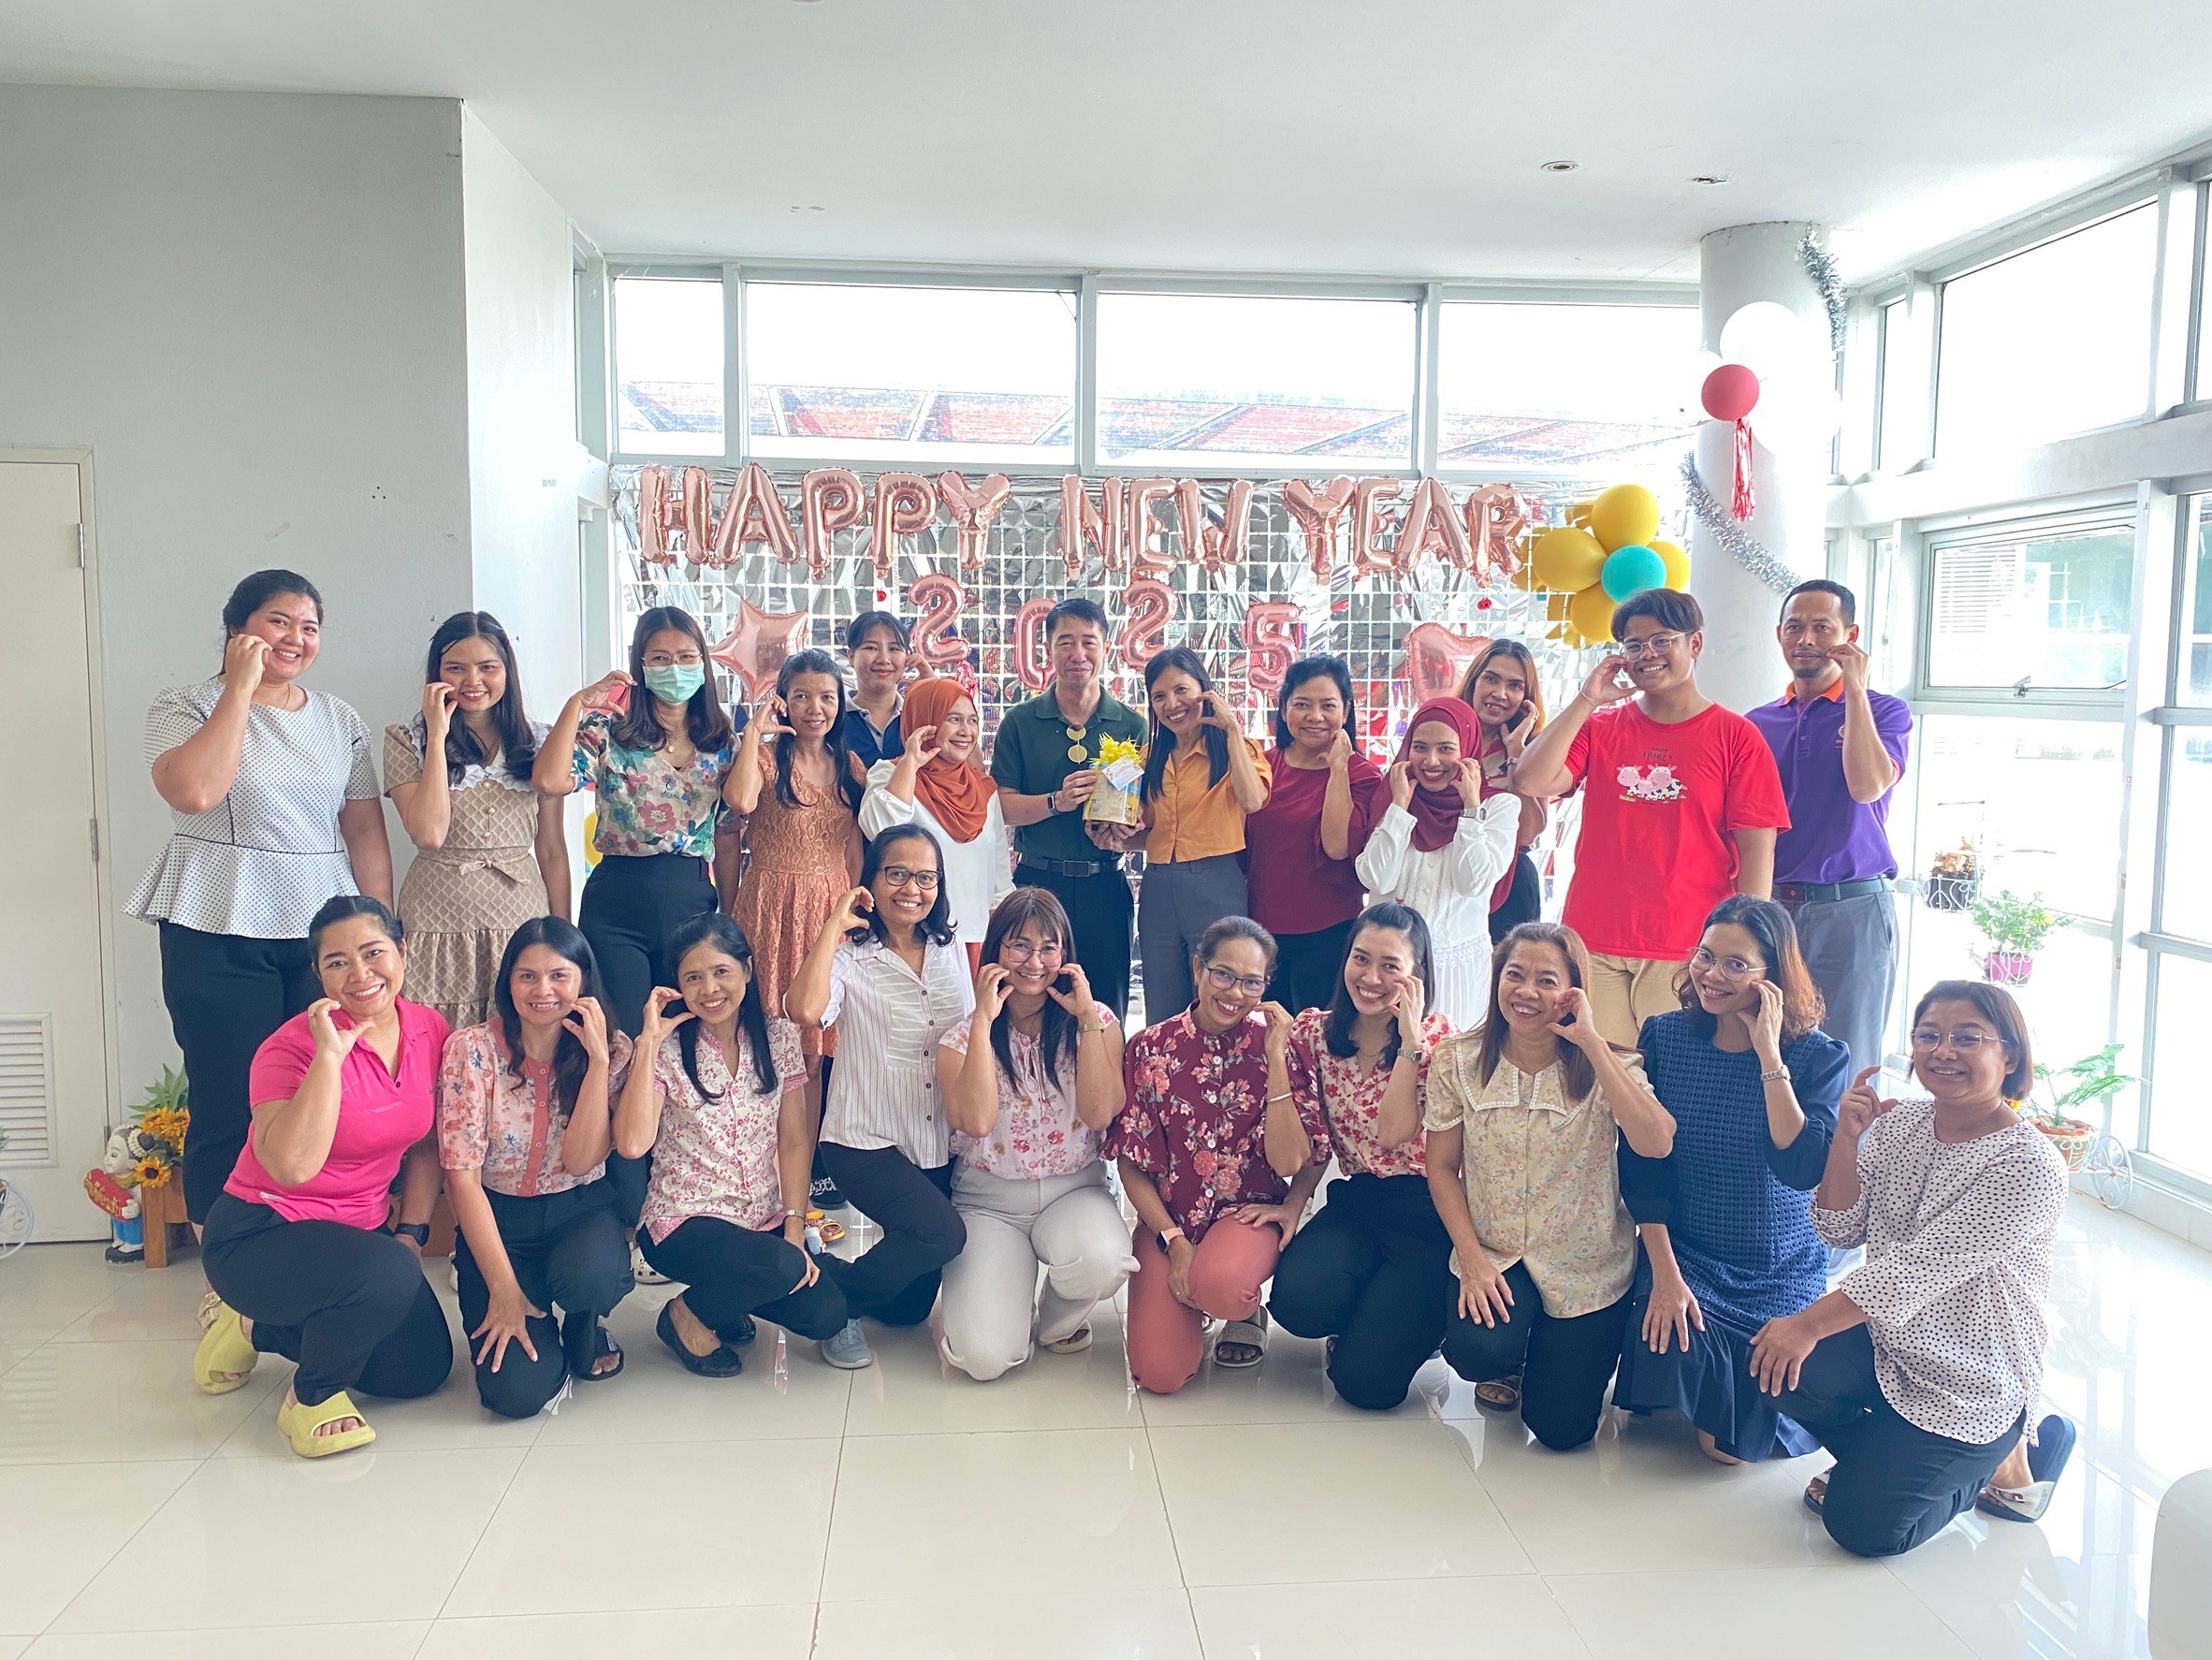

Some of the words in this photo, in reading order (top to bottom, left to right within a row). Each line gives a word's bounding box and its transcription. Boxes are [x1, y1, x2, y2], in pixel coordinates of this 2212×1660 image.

[638, 462, 1011, 580] HAPPY
[1058, 473, 1255, 581] NEW
[1282, 474, 1530, 588] YEAR
[1643, 751, 1673, 762] FAMILY
